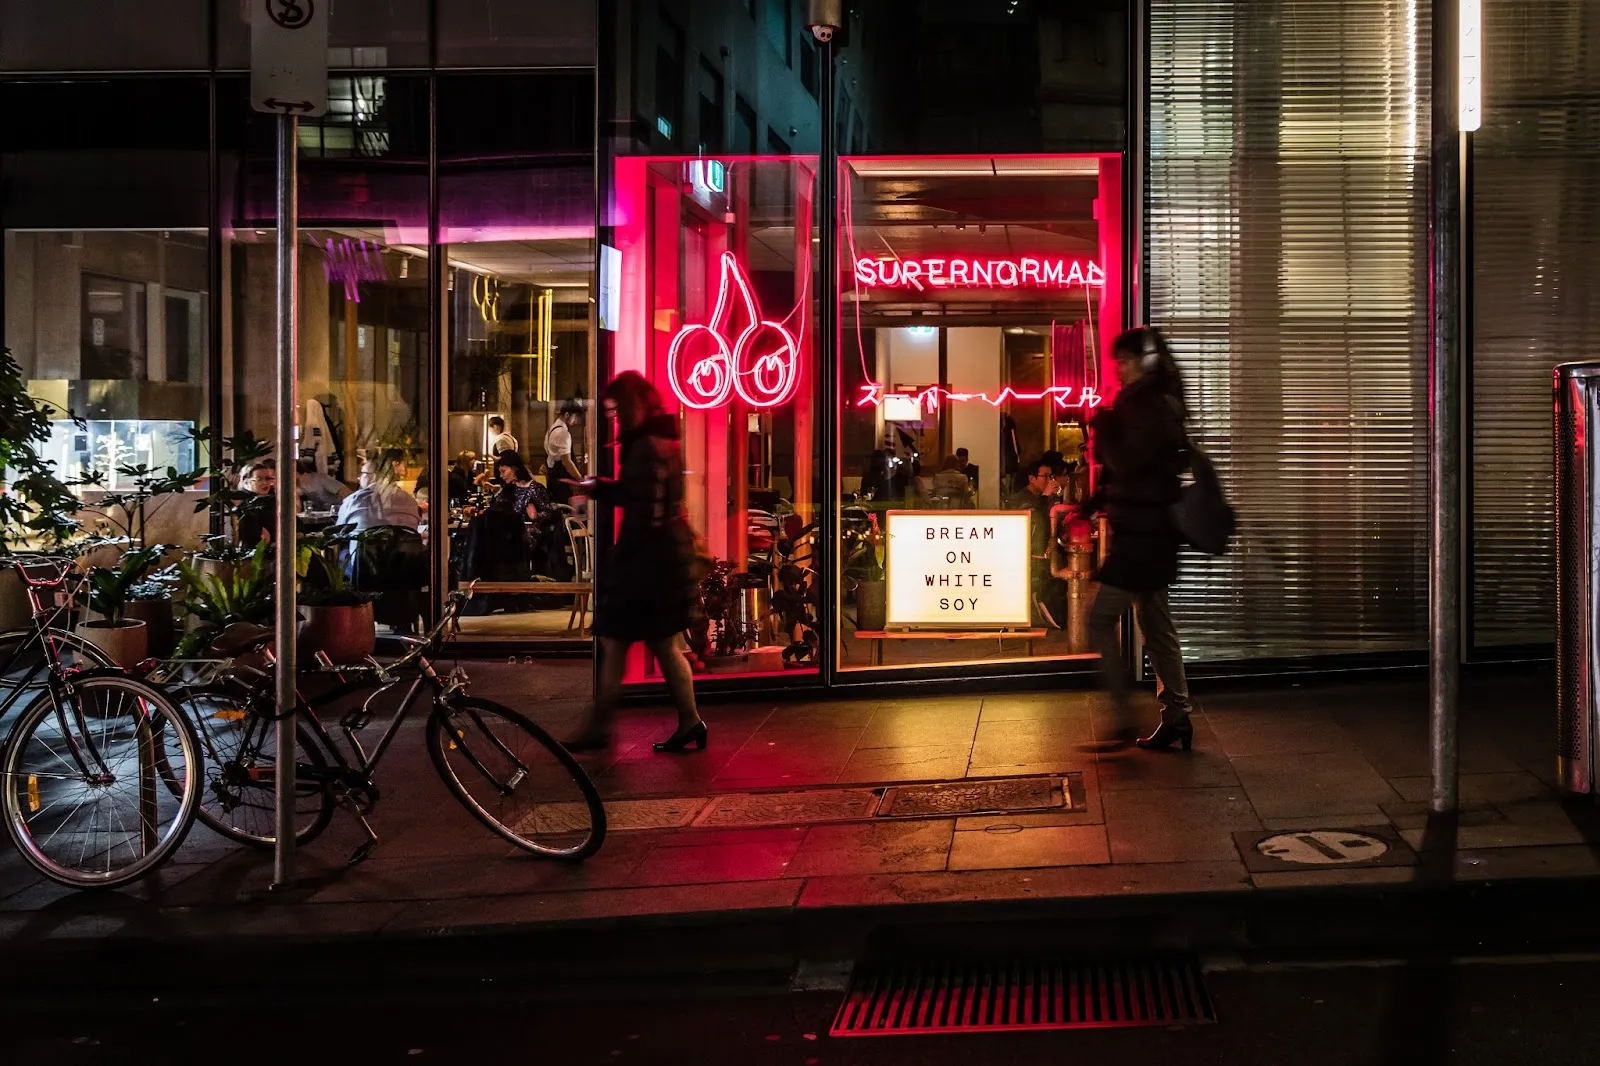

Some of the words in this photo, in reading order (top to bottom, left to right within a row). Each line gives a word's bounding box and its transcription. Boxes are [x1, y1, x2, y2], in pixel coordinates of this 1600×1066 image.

[856, 258, 1105, 286] SUPERNORMAL
[926, 527, 994, 540] BREAM
[946, 551, 971, 564] ON
[925, 574, 993, 587] WHITE
[940, 598, 979, 611] SOY
